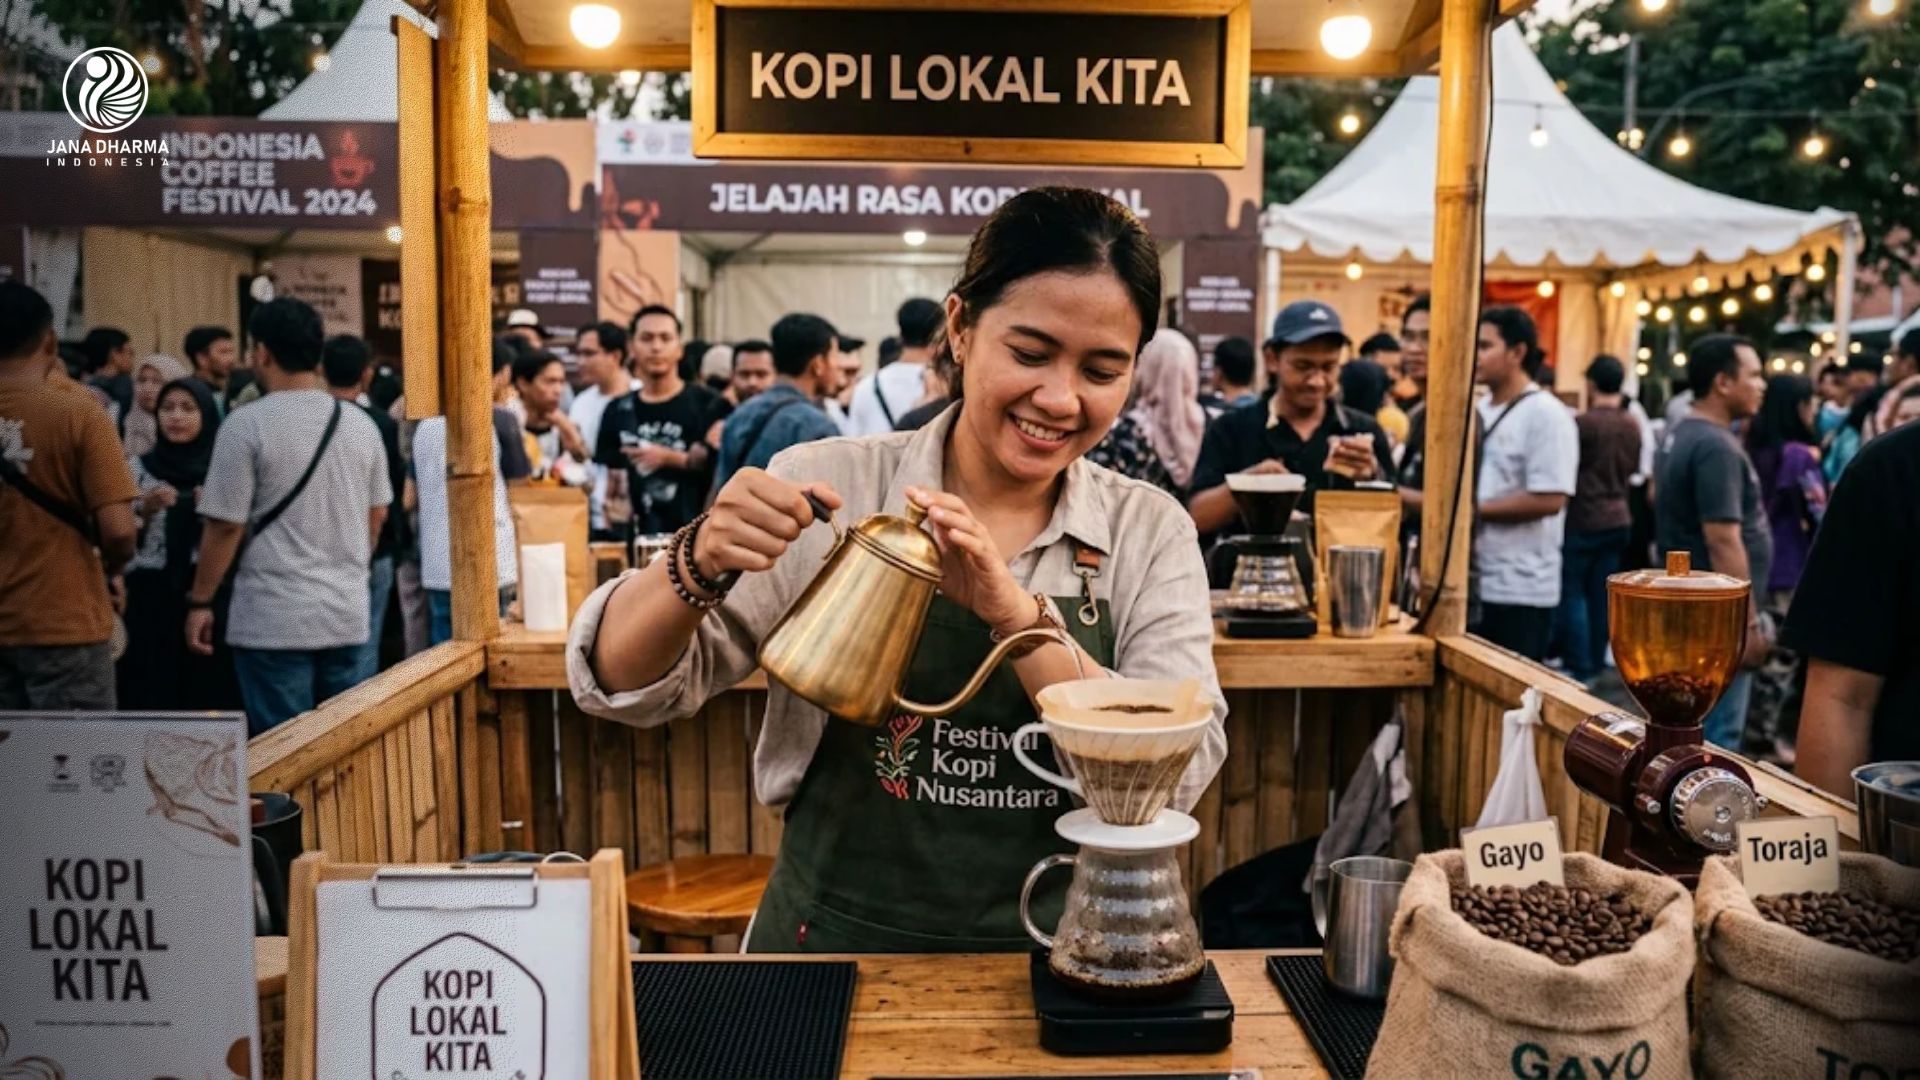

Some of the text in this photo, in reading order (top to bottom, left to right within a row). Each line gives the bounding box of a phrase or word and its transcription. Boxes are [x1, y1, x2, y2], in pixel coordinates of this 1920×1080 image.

[751, 52, 1191, 106] KOPI LOKAL KITA
[161, 131, 325, 160] INDONESIA
[161, 160, 275, 186] COFFEE
[162, 187, 377, 216] FESTIVAL 2024
[709, 183, 849, 213] JELAJAH
[856, 185, 945, 215] RASA
[932, 750, 996, 783] Kopi
[916, 776, 1059, 809] Nusantara
[1480, 841, 1544, 871] Gayo
[1747, 832, 1828, 865] Toraja
[45, 858, 145, 902] KOPI
[29, 908, 169, 951] LOKAL
[52, 958, 150, 1001] KITA
[424, 970, 493, 999] KOPI
[410, 1005, 507, 1036] LOKAL
[425, 1041, 492, 1072] KITA
[1511, 1040, 1652, 1080] GAYO
